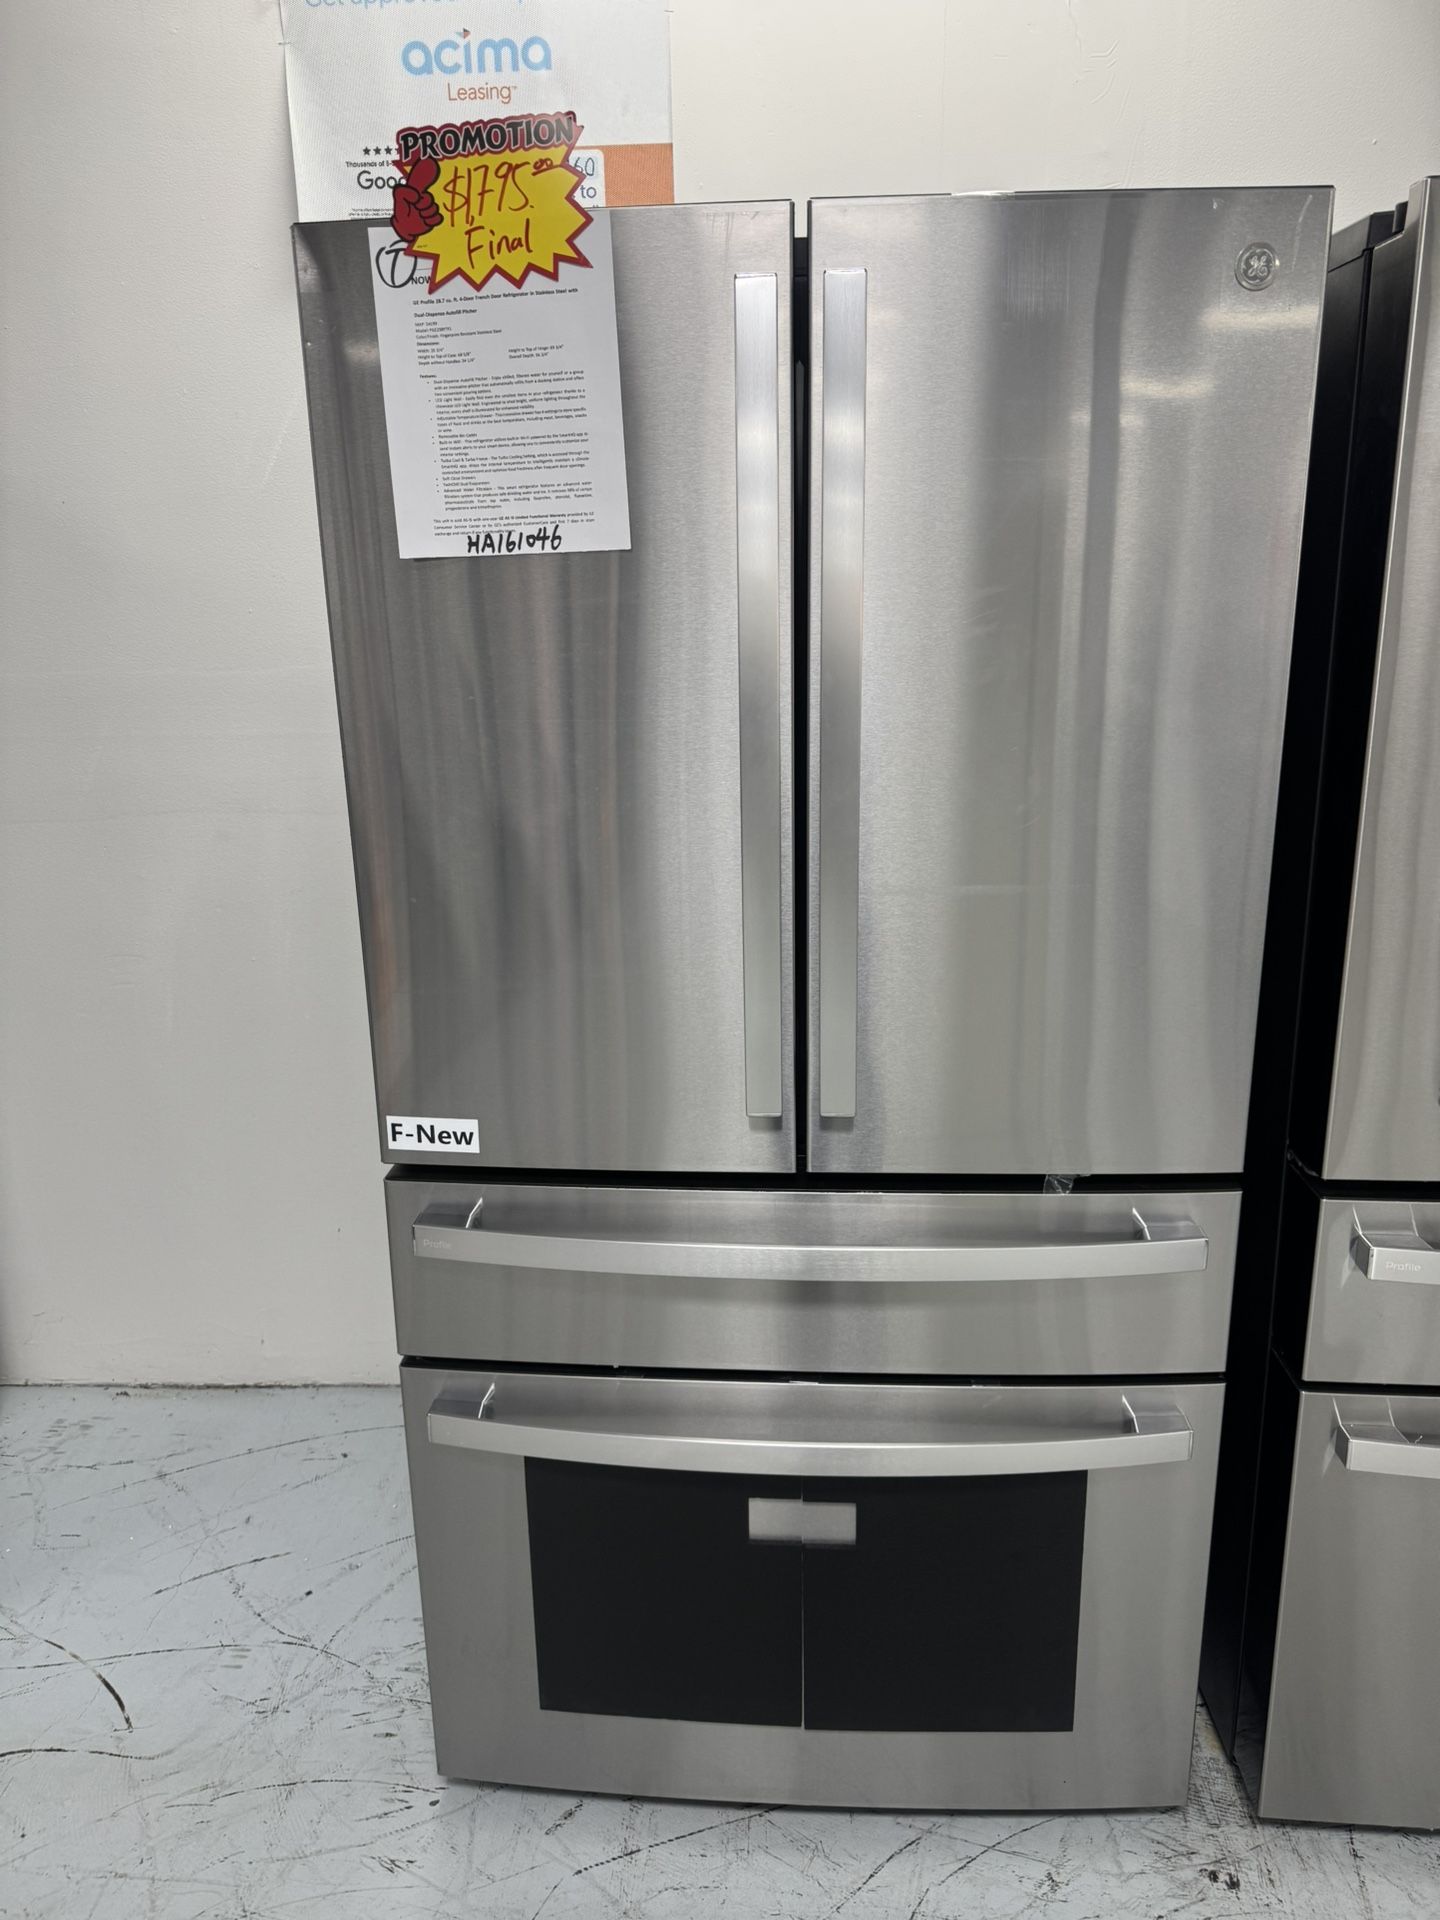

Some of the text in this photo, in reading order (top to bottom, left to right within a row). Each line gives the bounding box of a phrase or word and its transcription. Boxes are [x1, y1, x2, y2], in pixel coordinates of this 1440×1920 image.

[401, 29, 552, 76] acima
[401, 117, 574, 160] PROMOTION
[580, 185, 597, 199] to
[465, 218, 533, 269] Final
[467, 524, 562, 554] HA161046
[391, 1122, 474, 1146] F-New
[1385, 1260, 1422, 1273] Profile
